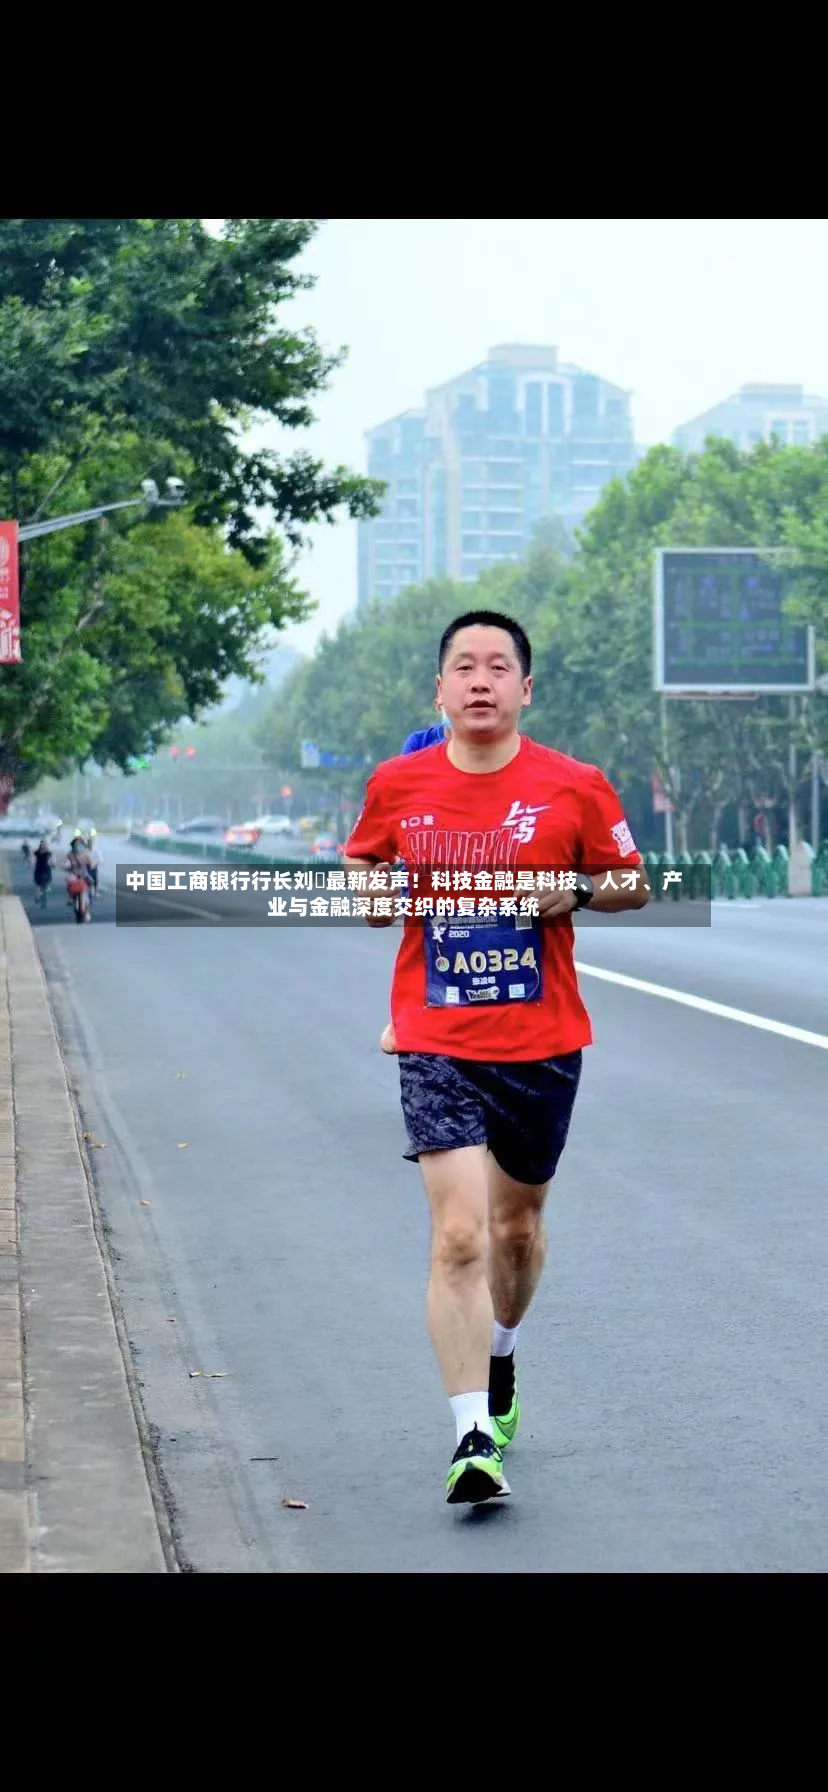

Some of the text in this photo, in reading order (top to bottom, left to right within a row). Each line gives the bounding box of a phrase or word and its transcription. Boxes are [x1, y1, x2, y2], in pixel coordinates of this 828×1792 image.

[407, 827, 521, 876] SHANGHAI
[448, 930, 470, 938] 2020
[453, 947, 536, 973] A0324
